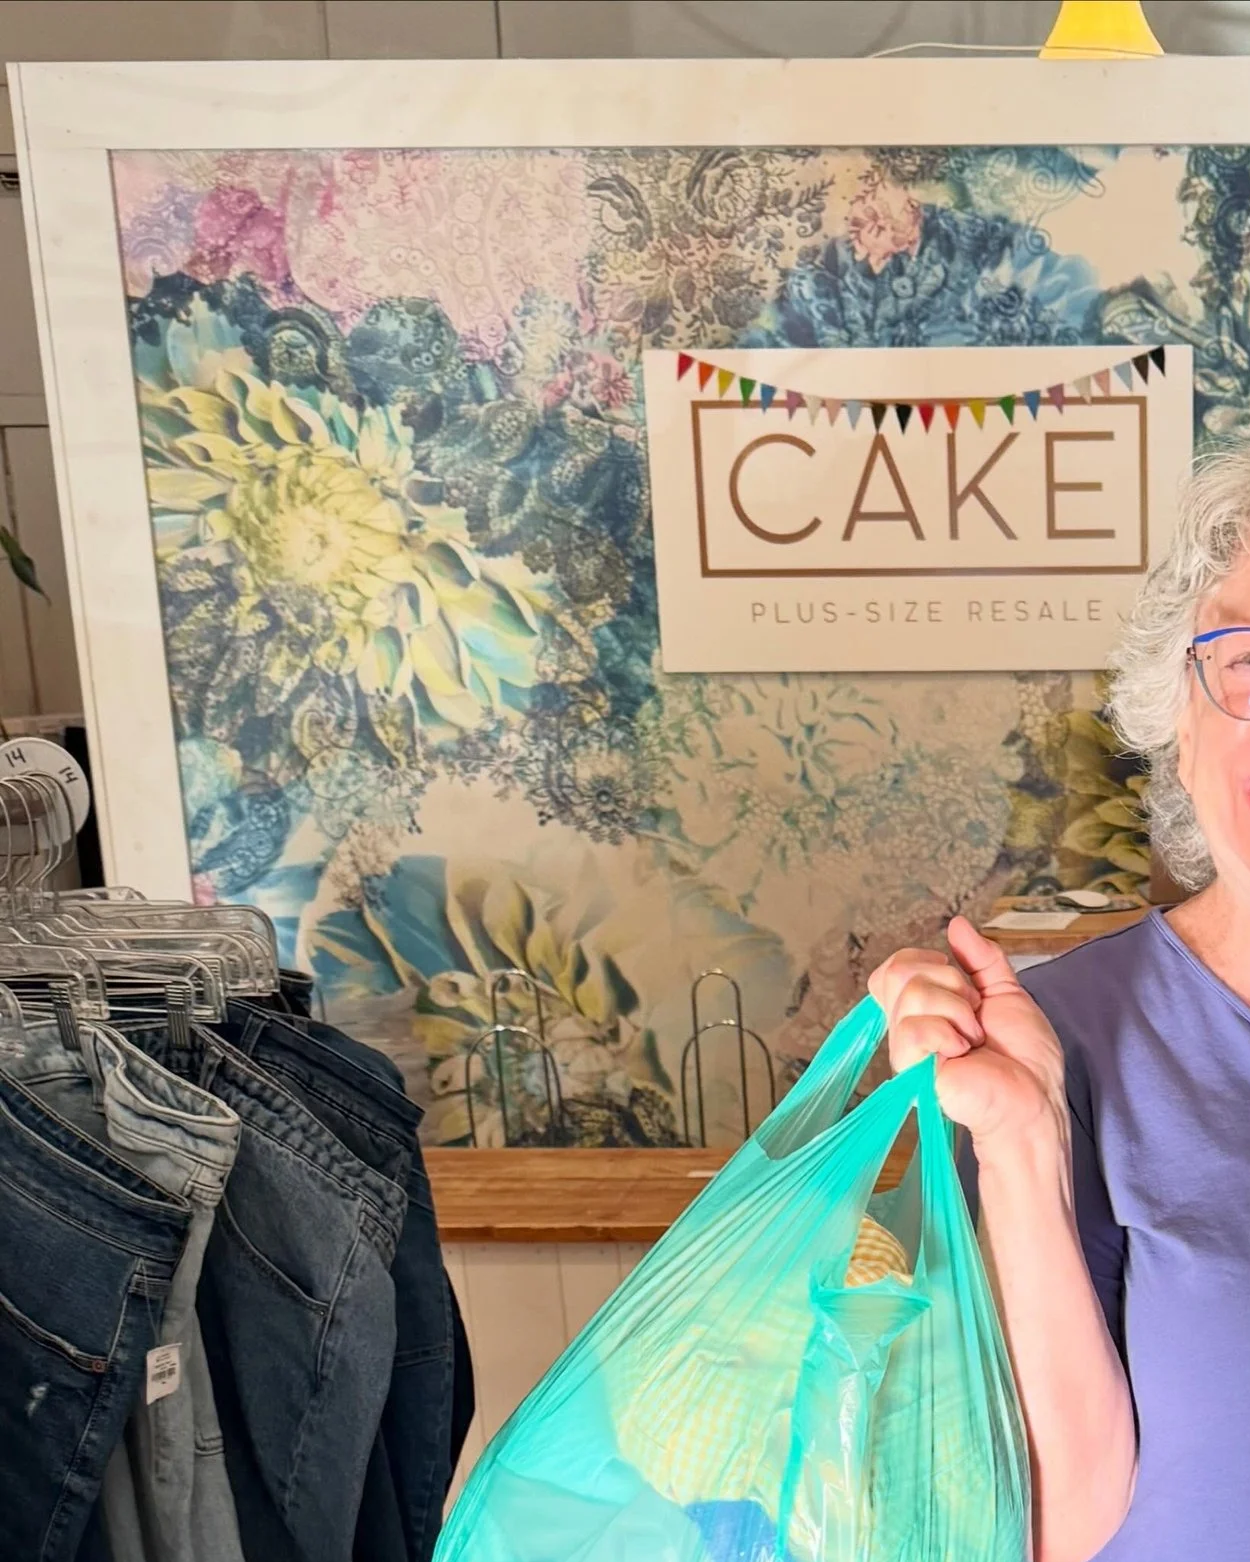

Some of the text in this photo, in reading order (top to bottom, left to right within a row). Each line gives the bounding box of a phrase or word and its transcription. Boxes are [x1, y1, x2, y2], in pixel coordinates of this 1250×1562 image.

[728, 431, 1116, 545] CAKE
[751, 599, 1104, 623] PLUS-SIZE RESALE
[5, 747, 27, 768] 14
[58, 766, 79, 784] 14
